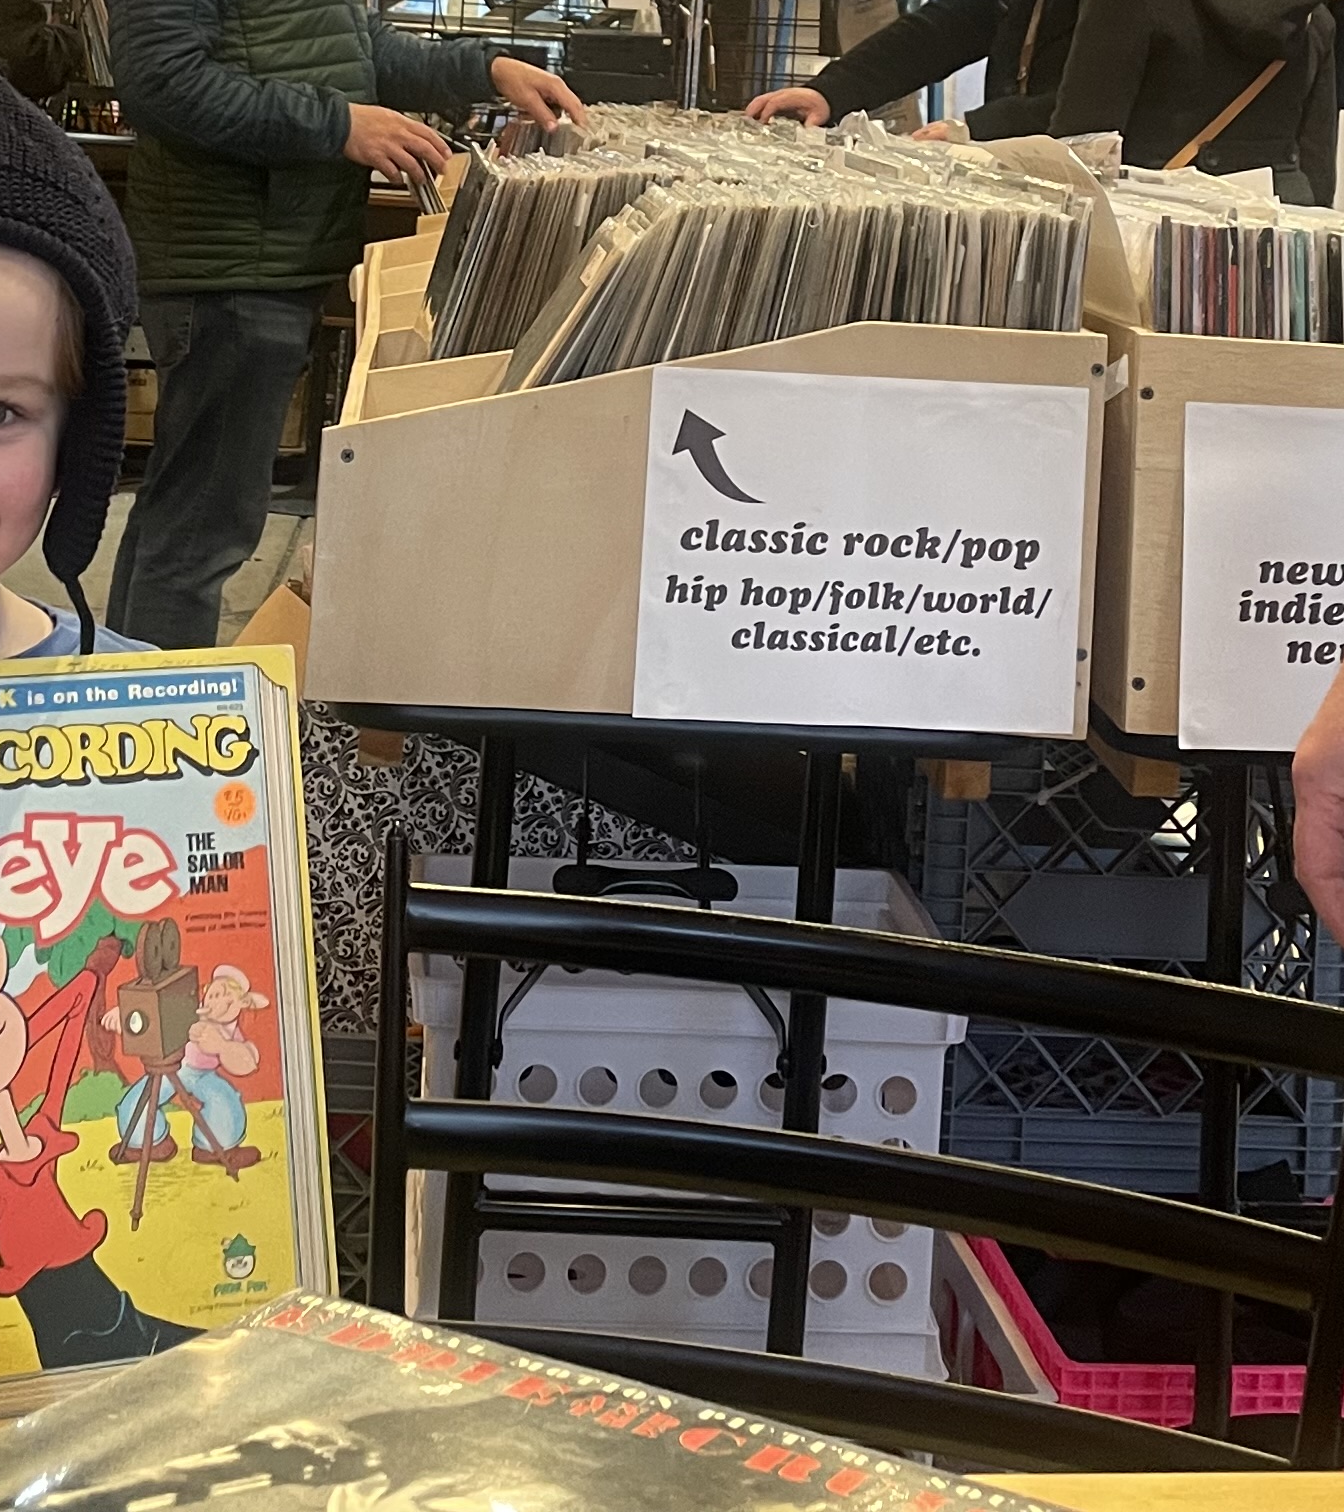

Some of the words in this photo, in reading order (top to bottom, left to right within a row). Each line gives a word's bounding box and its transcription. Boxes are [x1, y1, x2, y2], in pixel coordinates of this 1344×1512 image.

[680, 519, 829, 556] classic
[842, 527, 1041, 570] rock/pop
[665, 575, 728, 611] hip
[739, 578, 1053, 619] hop/folk/world/
[731, 621, 982, 657] classical/etc.
[27, 690, 45, 706] is
[53, 689, 78, 704] on
[86, 686, 118, 701] the
[127, 677, 238, 701] Recording!
[185, 831, 216, 852] THE
[187, 850, 245, 874] SAILOR
[189, 874, 229, 895] MAN
